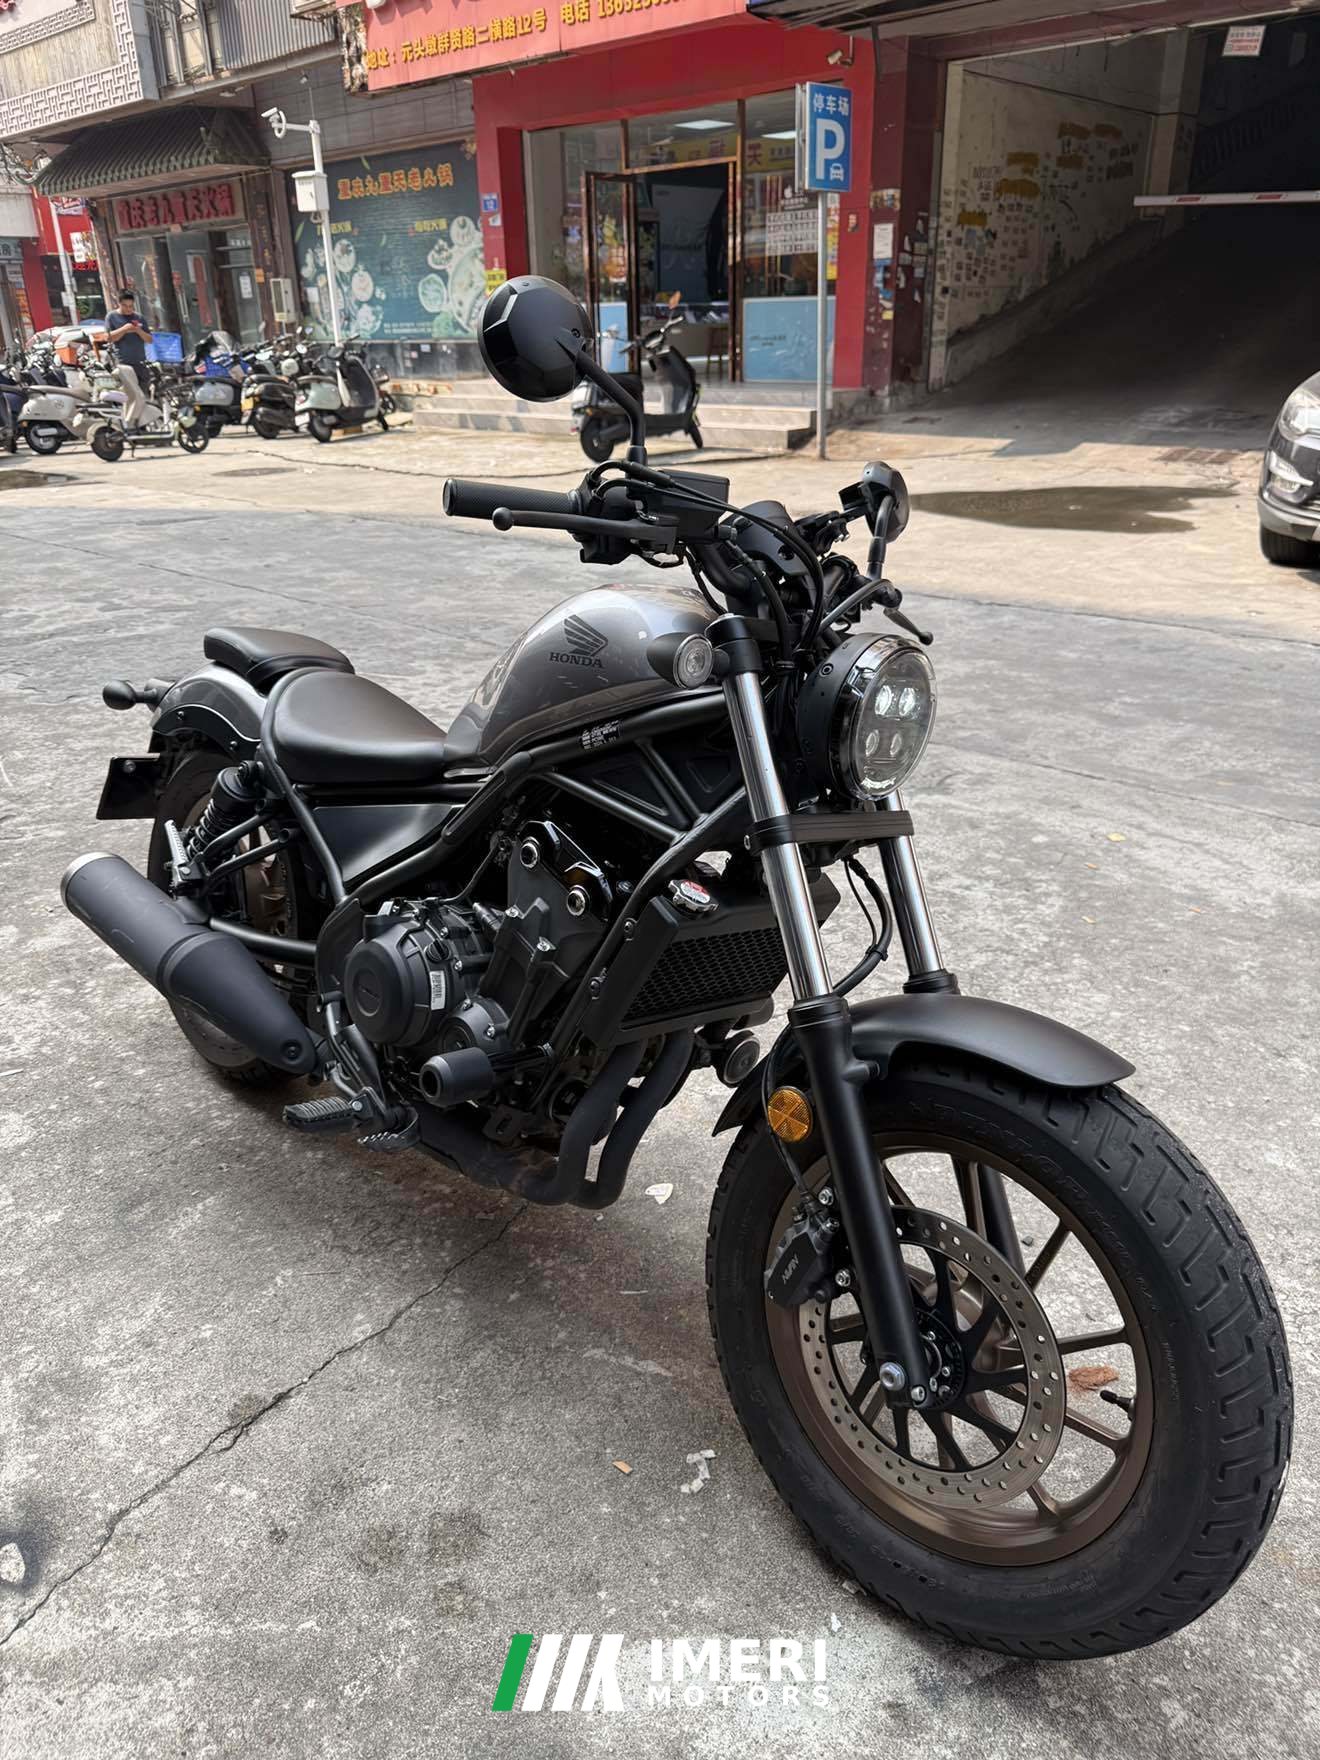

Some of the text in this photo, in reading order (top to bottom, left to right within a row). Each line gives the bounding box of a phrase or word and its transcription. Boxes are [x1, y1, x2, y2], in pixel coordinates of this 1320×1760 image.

[561, 0, 592, 25] 电话
[813, 92, 849, 116] 停车场
[816, 118, 845, 180] P
[550, 652, 603, 668] HONDA
